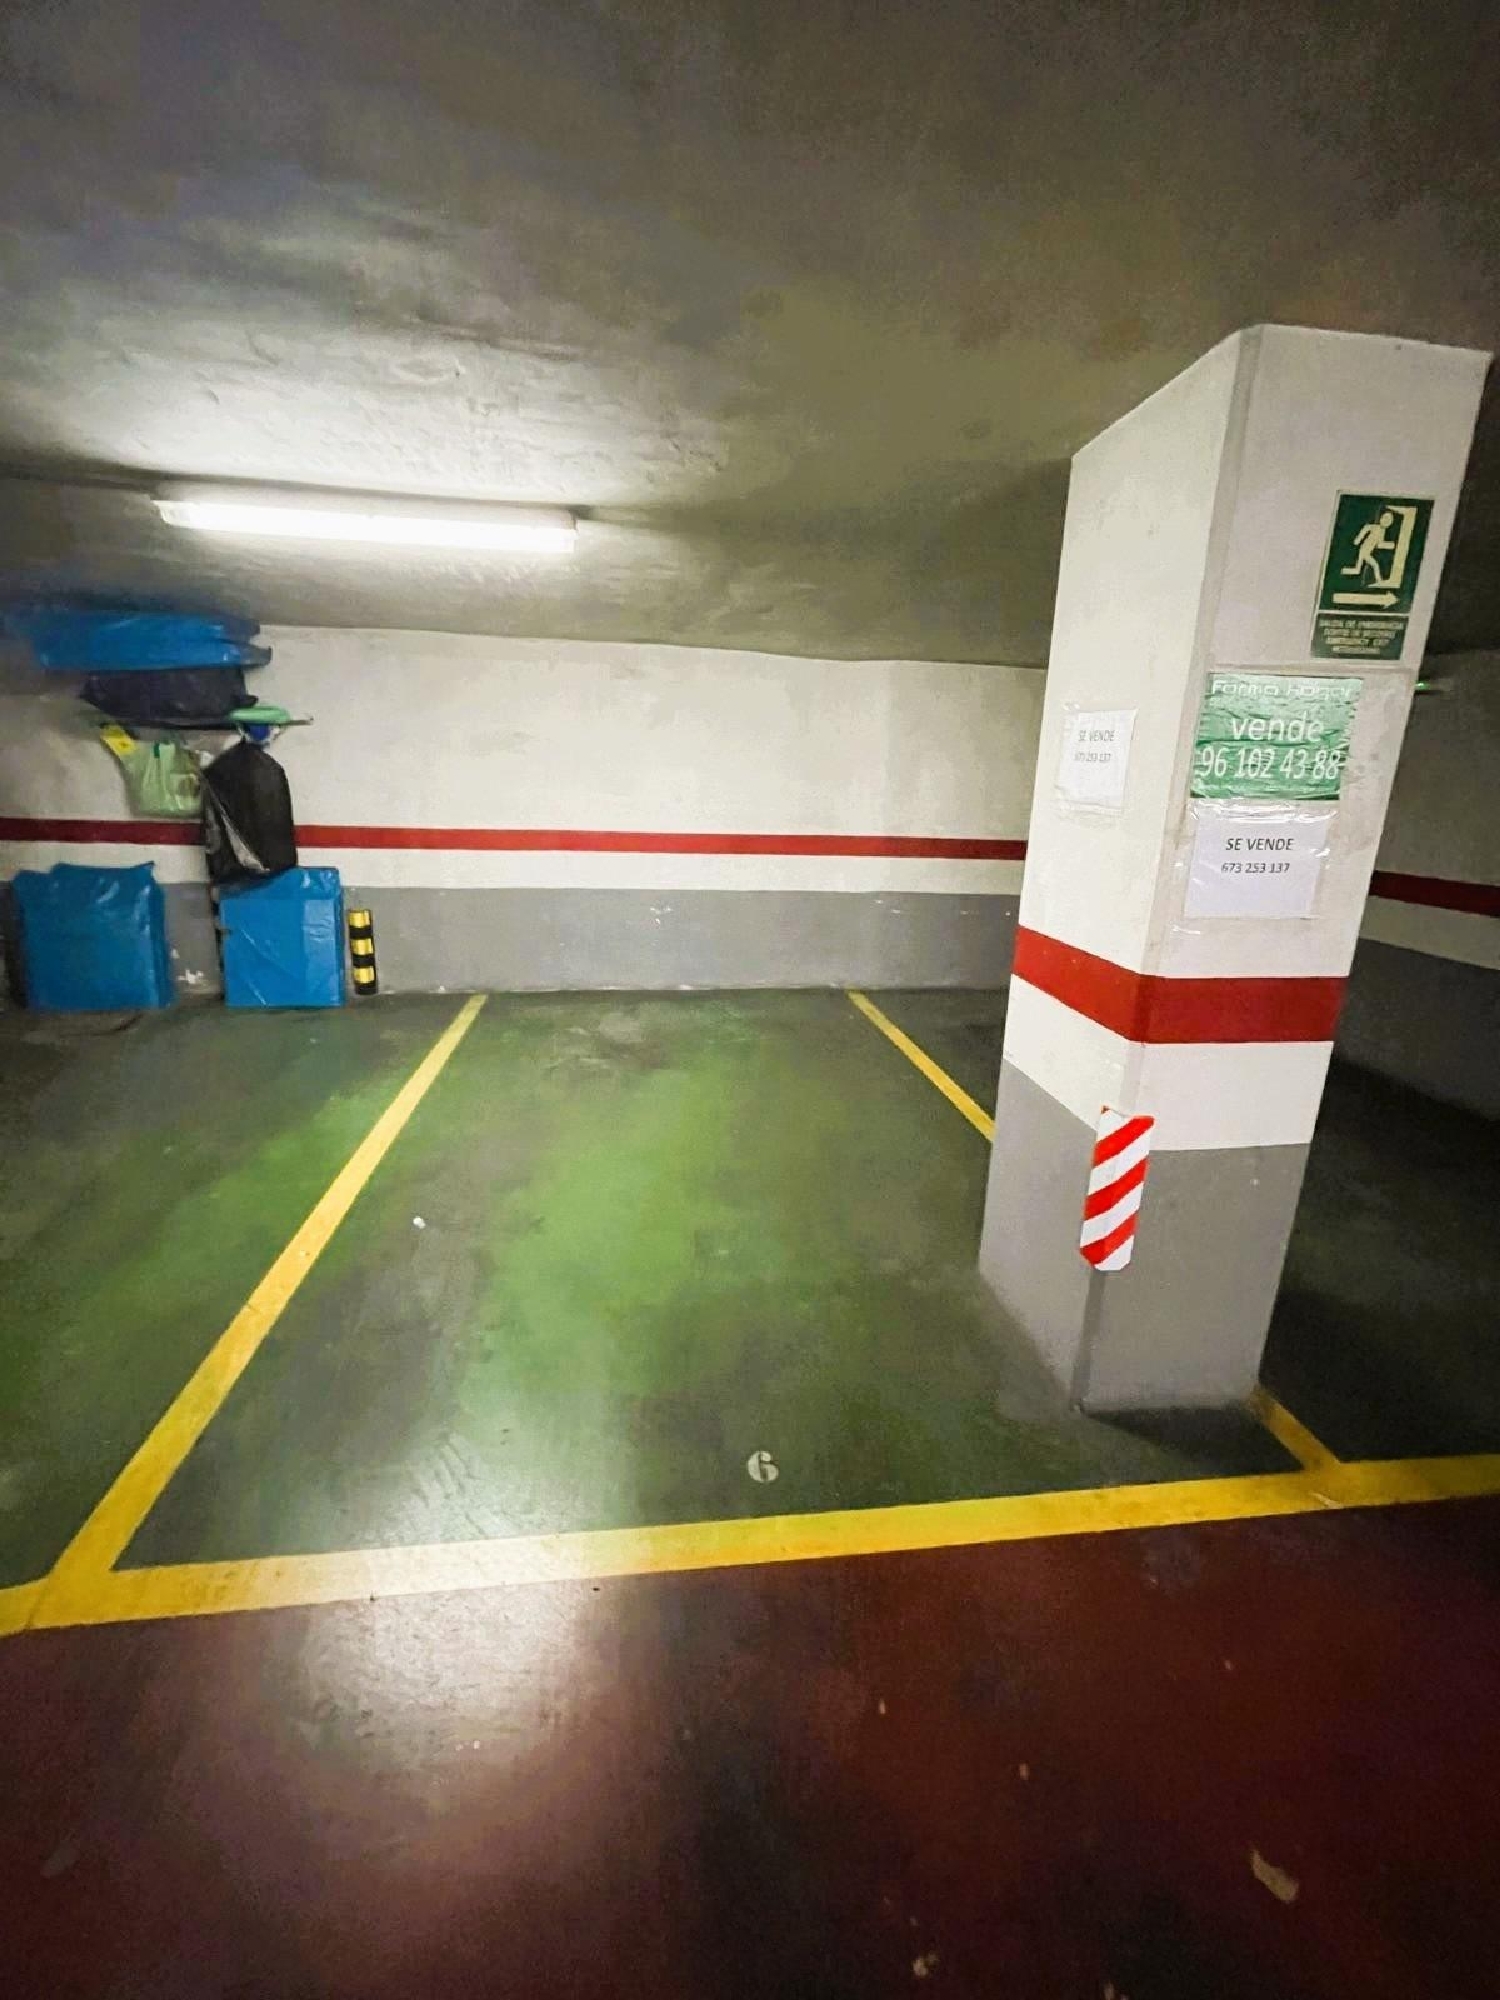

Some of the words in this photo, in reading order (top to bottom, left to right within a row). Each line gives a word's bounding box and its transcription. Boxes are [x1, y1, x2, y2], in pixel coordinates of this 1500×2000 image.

[1232, 711, 1325, 742] vende
[1195, 747, 1230, 777] 96
[1235, 748, 1276, 779] 102
[1280, 749, 1309, 780] 43
[1312, 750, 1341, 780] 88
[1225, 838, 1242, 851] SE
[1245, 838, 1295, 851] VENDE
[1221, 862, 1242, 873] 673
[1245, 863, 1266, 873] 253
[1268, 863, 1291, 873] 137
[747, 1450, 779, 1483] 6
